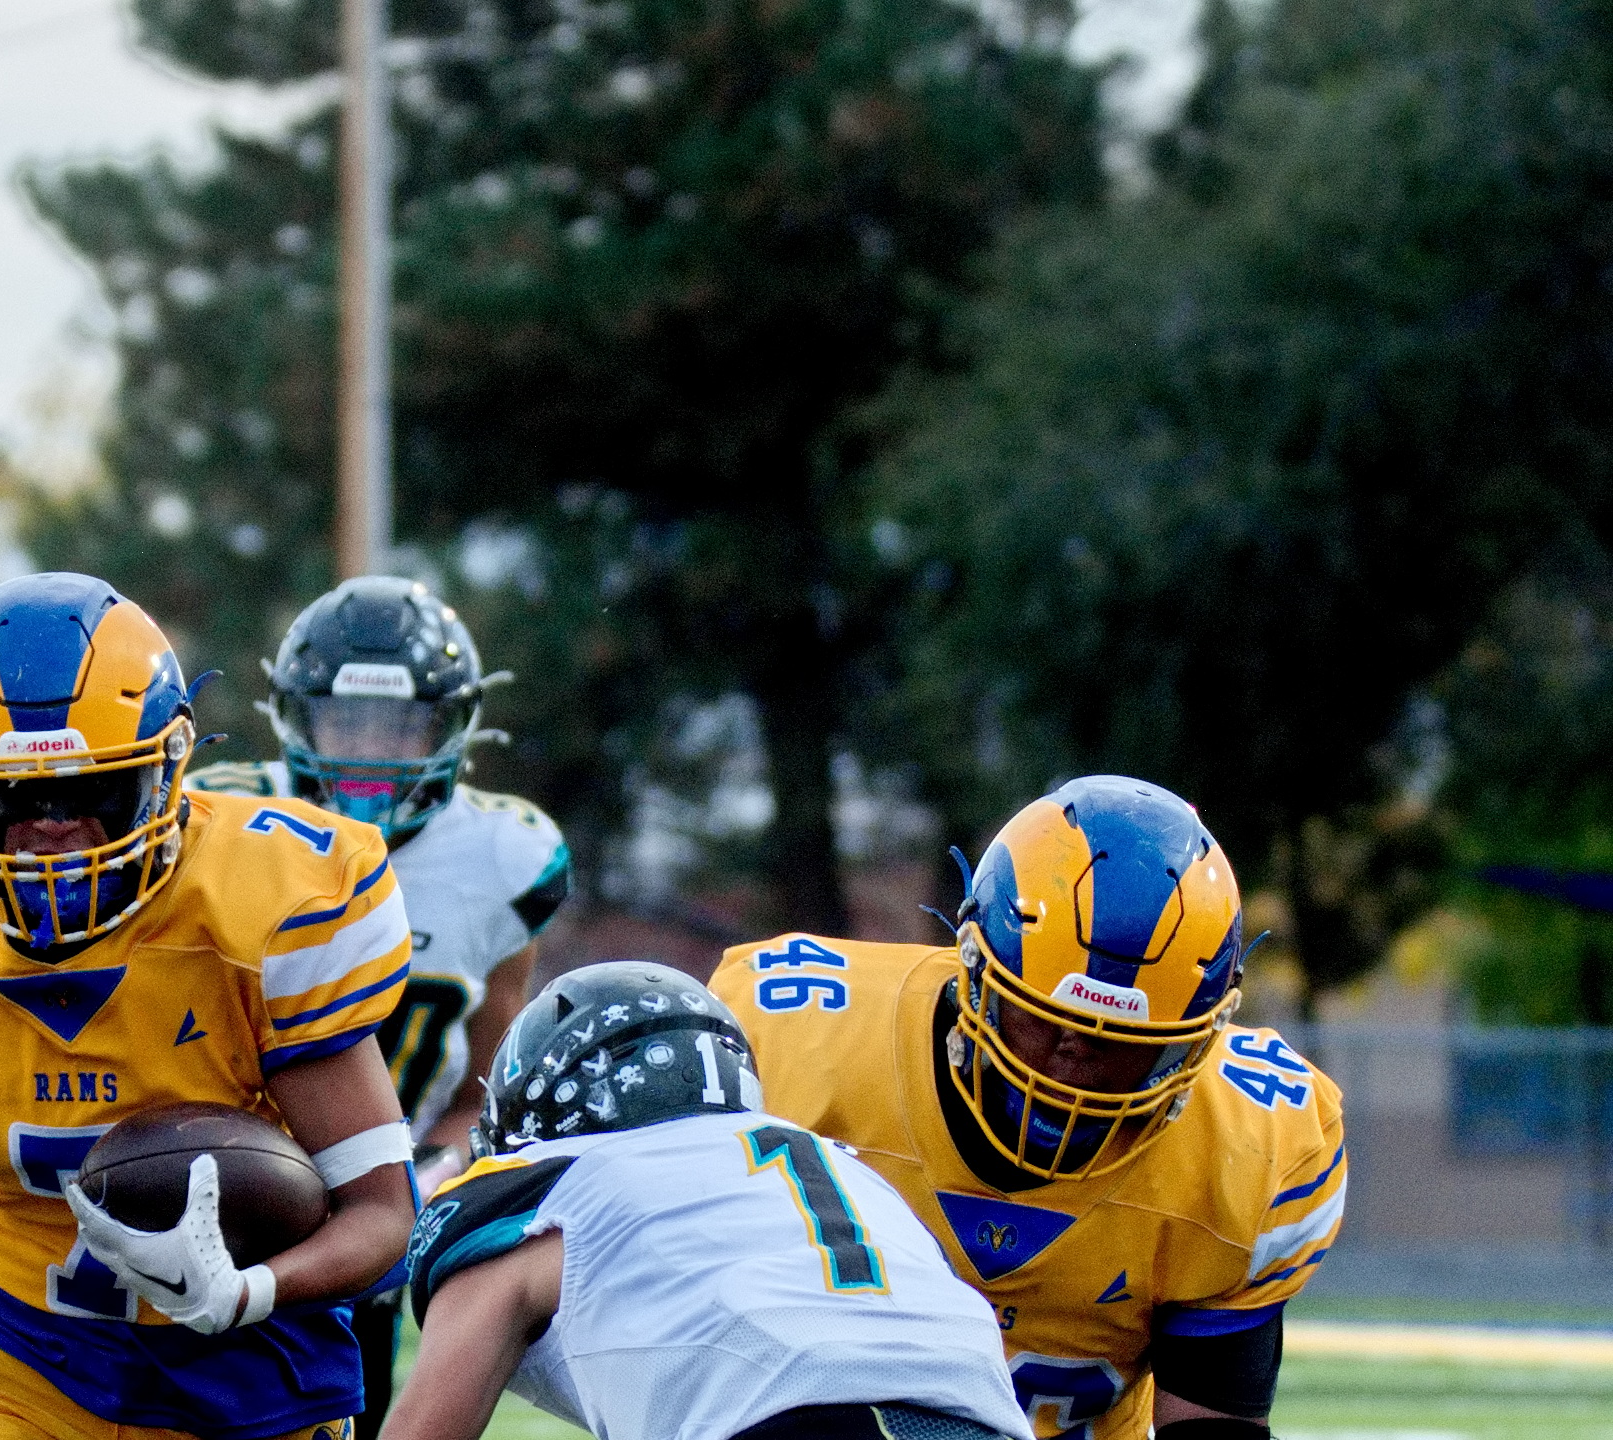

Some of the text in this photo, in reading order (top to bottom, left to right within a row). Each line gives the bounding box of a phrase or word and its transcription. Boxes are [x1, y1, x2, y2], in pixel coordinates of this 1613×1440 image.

[243, 807, 337, 857] 7
[755, 937, 850, 1014] 46
[34, 1072, 119, 1103] RAMS
[695, 1032, 726, 1104] 1
[1218, 1030, 1313, 1112] 46
[736, 1122, 891, 1296] 1
